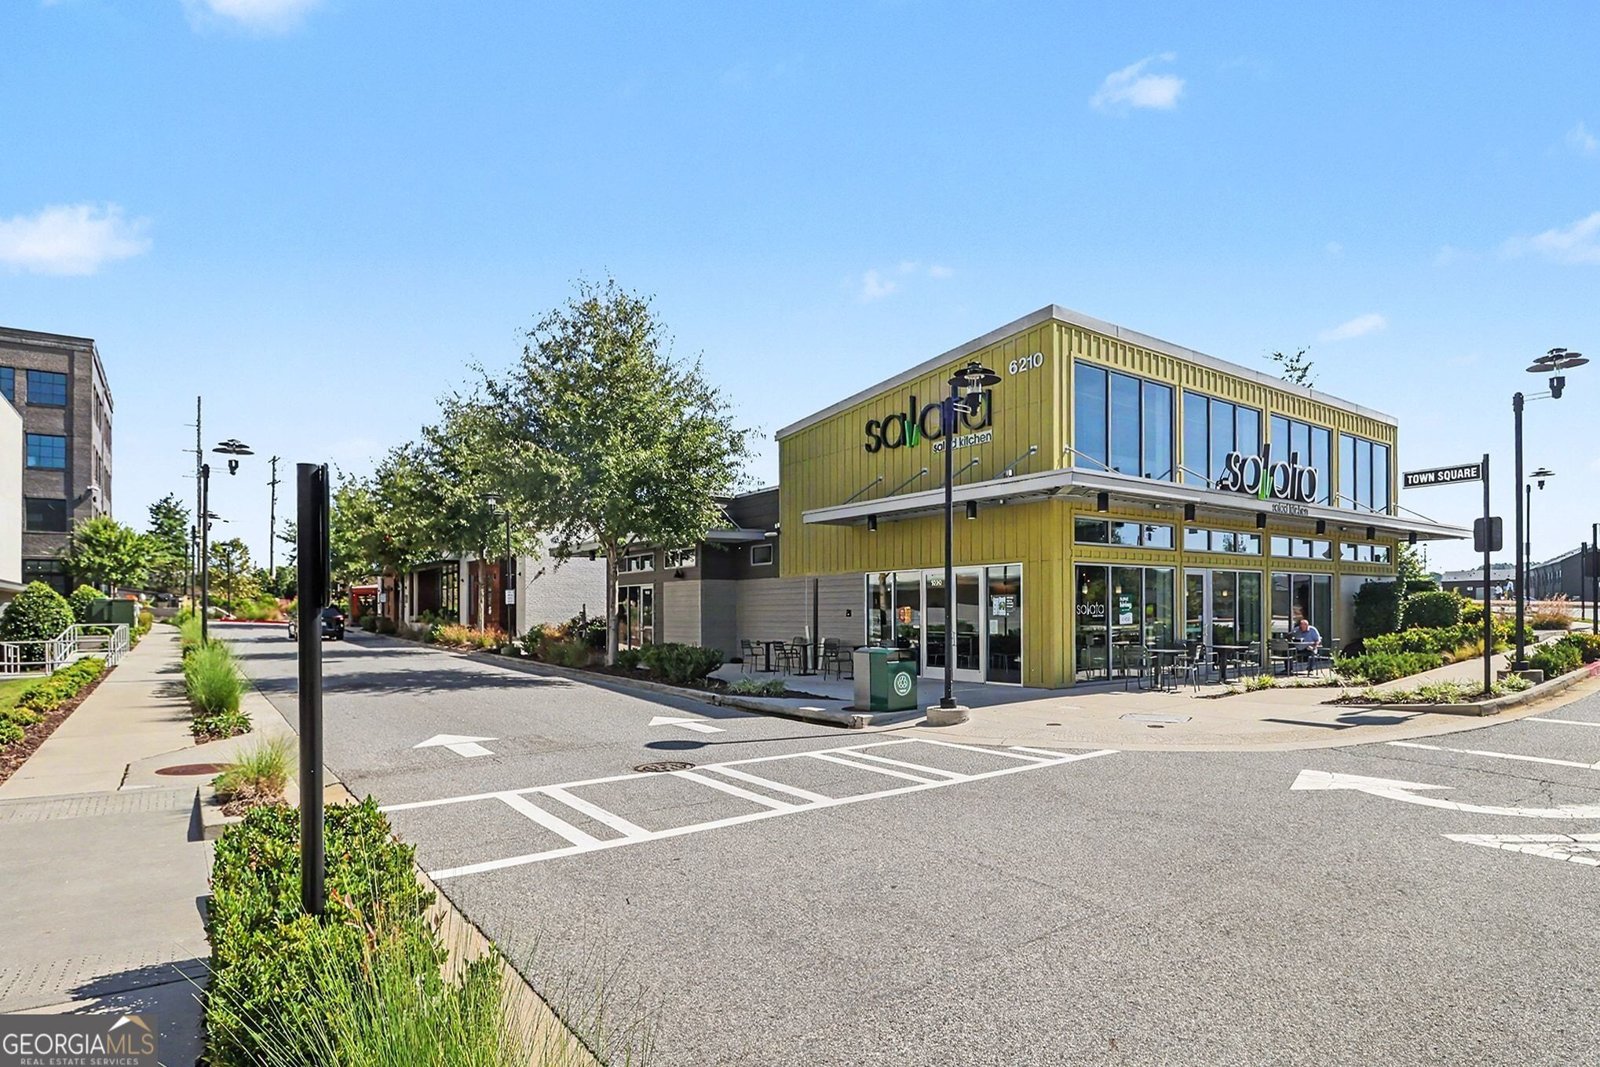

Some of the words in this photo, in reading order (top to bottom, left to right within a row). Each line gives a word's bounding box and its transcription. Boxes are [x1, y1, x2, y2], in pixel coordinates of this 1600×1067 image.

[1008, 352, 1044, 376] 6210
[933, 438, 957, 452] sald
[959, 432, 992, 447] kitchen
[1225, 443, 1318, 503] salata
[1407, 473, 1435, 485] TOWN
[1437, 467, 1477, 481] SQUARE
[1076, 601, 1105, 615] salata
